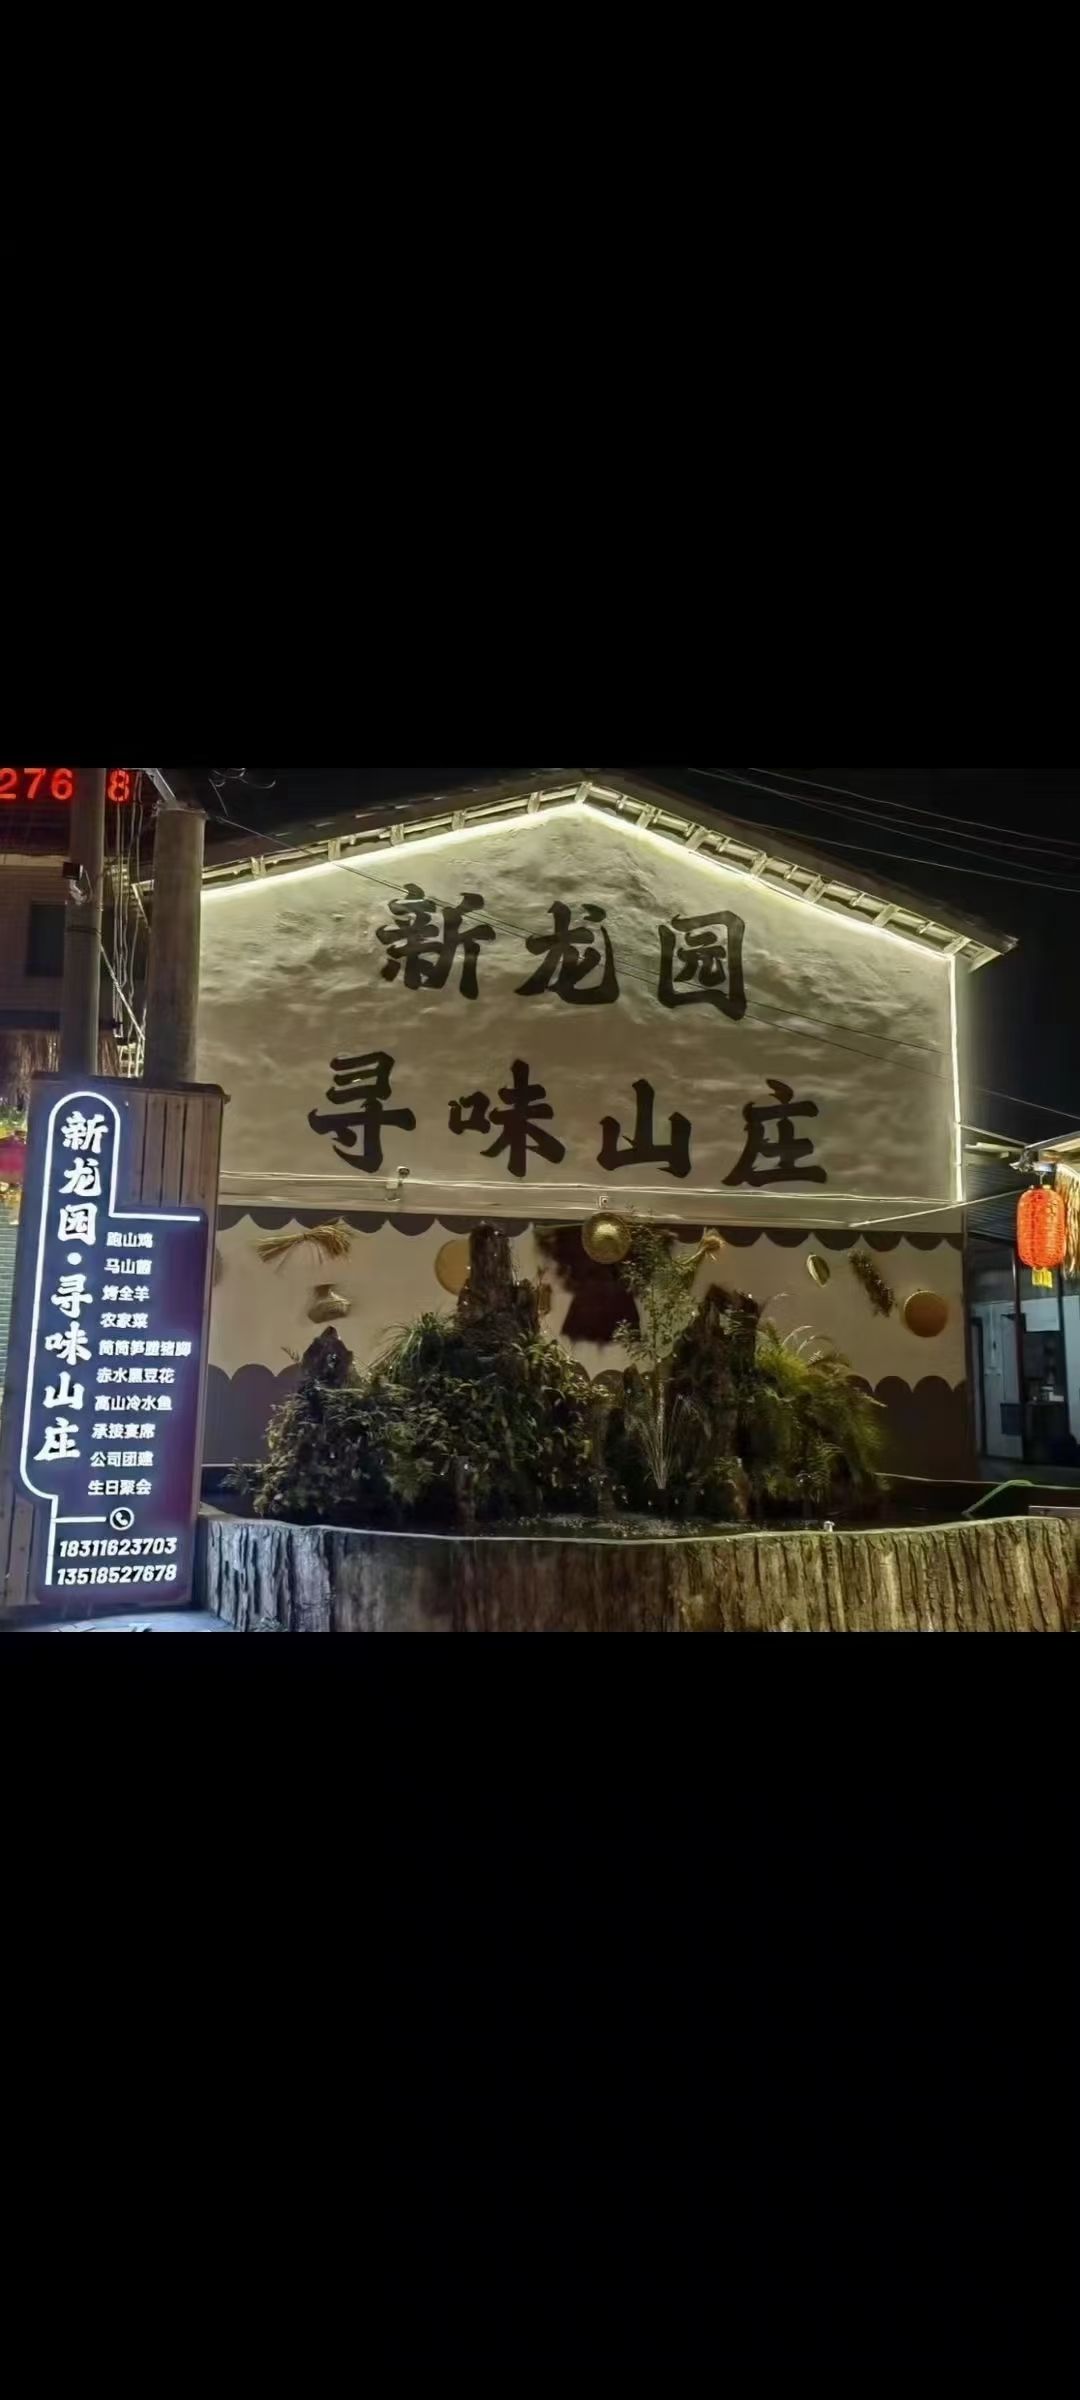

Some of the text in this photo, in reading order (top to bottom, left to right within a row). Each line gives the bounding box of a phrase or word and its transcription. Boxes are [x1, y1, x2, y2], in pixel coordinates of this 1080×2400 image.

[0, 768, 131, 801] 2768
[376, 882, 747, 1021] 新龙园
[308, 1051, 828, 1187] 寻味山庄
[106, 1231, 153, 1249] 跑山鸡
[101, 1284, 150, 1302] 烤全羊
[99, 1311, 149, 1329] 农家菜
[96, 1366, 175, 1384] 赤水黑豆花
[94, 1394, 173, 1411] 高山冷水鱼
[91, 1423, 156, 1440] 承接宴席
[89, 1451, 154, 1468] 公司团建
[87, 1478, 152, 1496] 生日聚会
[59, 1537, 178, 1558] 18311623703
[56, 1564, 178, 1586] 13518527678
